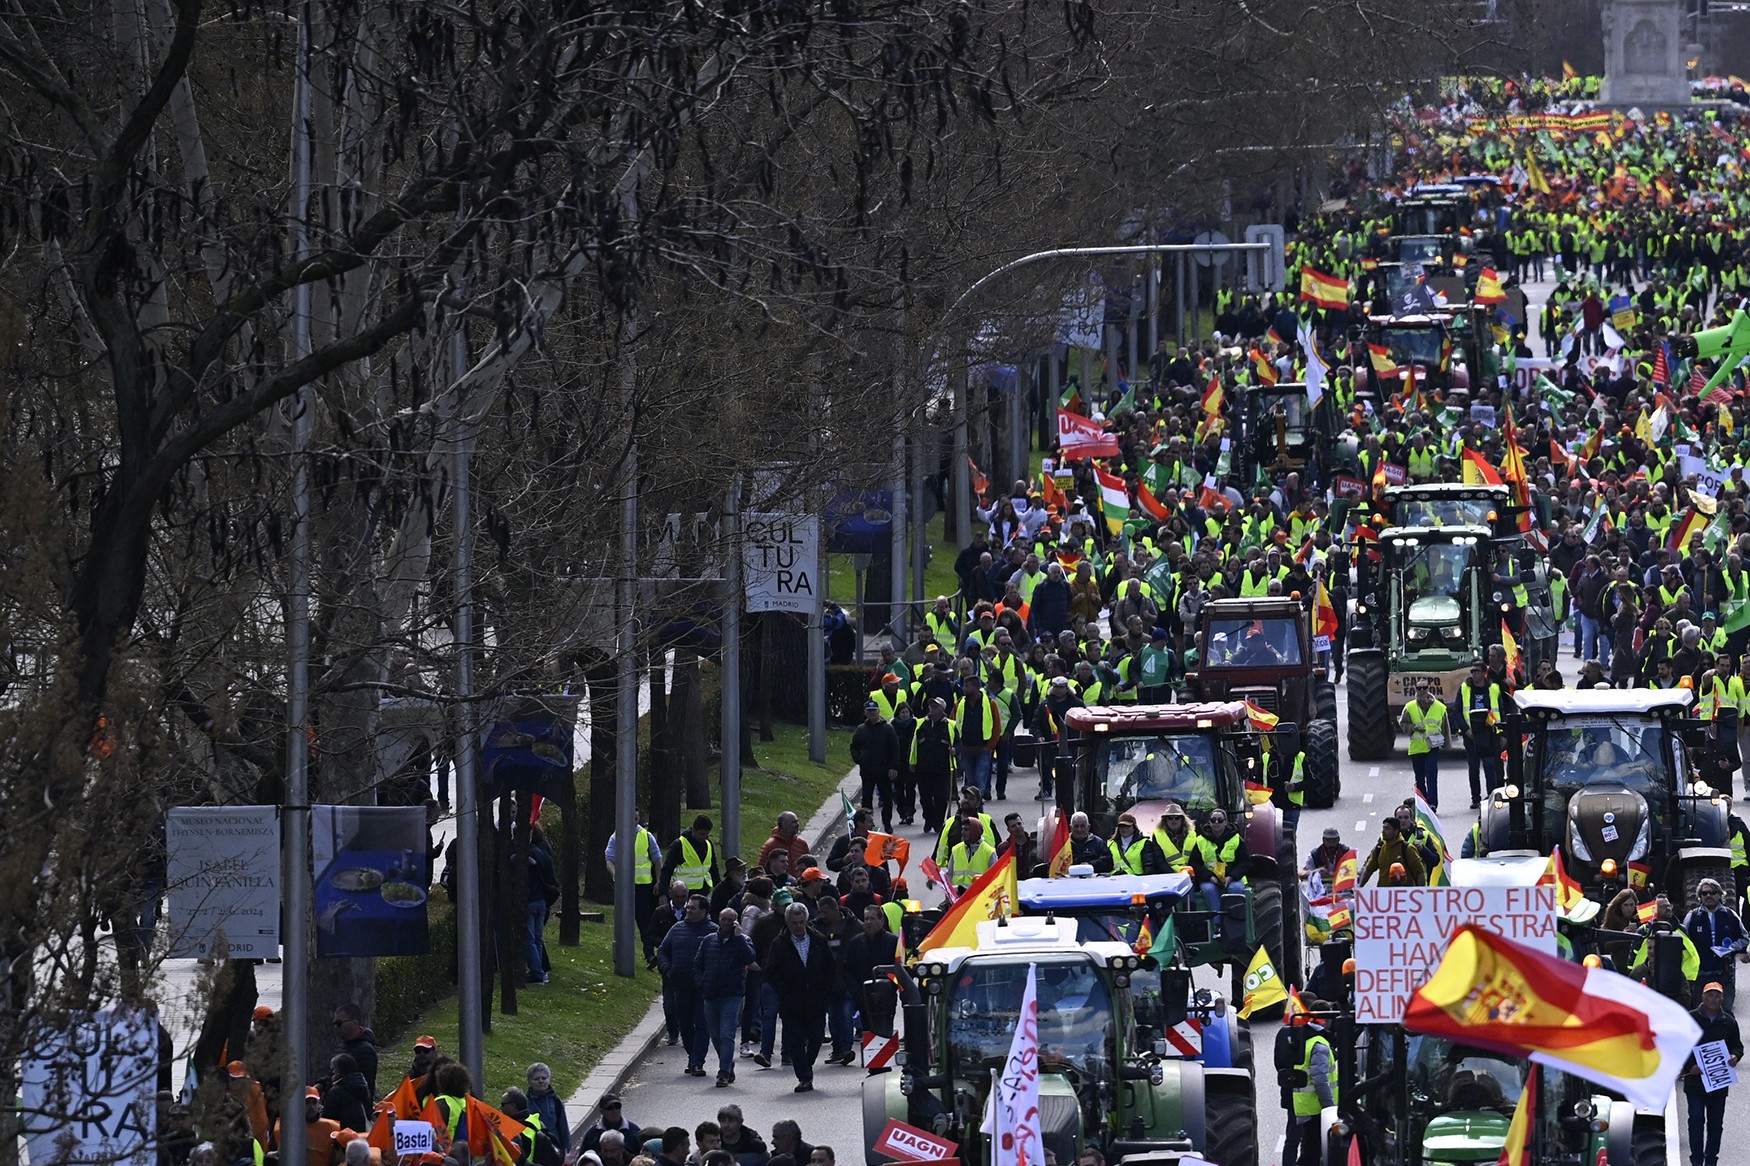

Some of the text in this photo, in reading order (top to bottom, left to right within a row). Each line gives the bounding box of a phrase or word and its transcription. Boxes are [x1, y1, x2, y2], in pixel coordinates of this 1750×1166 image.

[746, 521, 803, 545] CUL
[756, 546, 794, 568] TU
[778, 571, 813, 596] RA
[772, 600, 799, 609] MADRID
[1403, 677, 1442, 688] CAPO
[1355, 888, 1555, 913] NUESTRO FIN
[1355, 915, 1424, 941] SERA
[1700, 1043, 1733, 1088] ¡JUSTICIA!
[81, 1101, 149, 1141] RA
[396, 1130, 432, 1151] Basta!
[891, 1130, 945, 1159] UAGN
